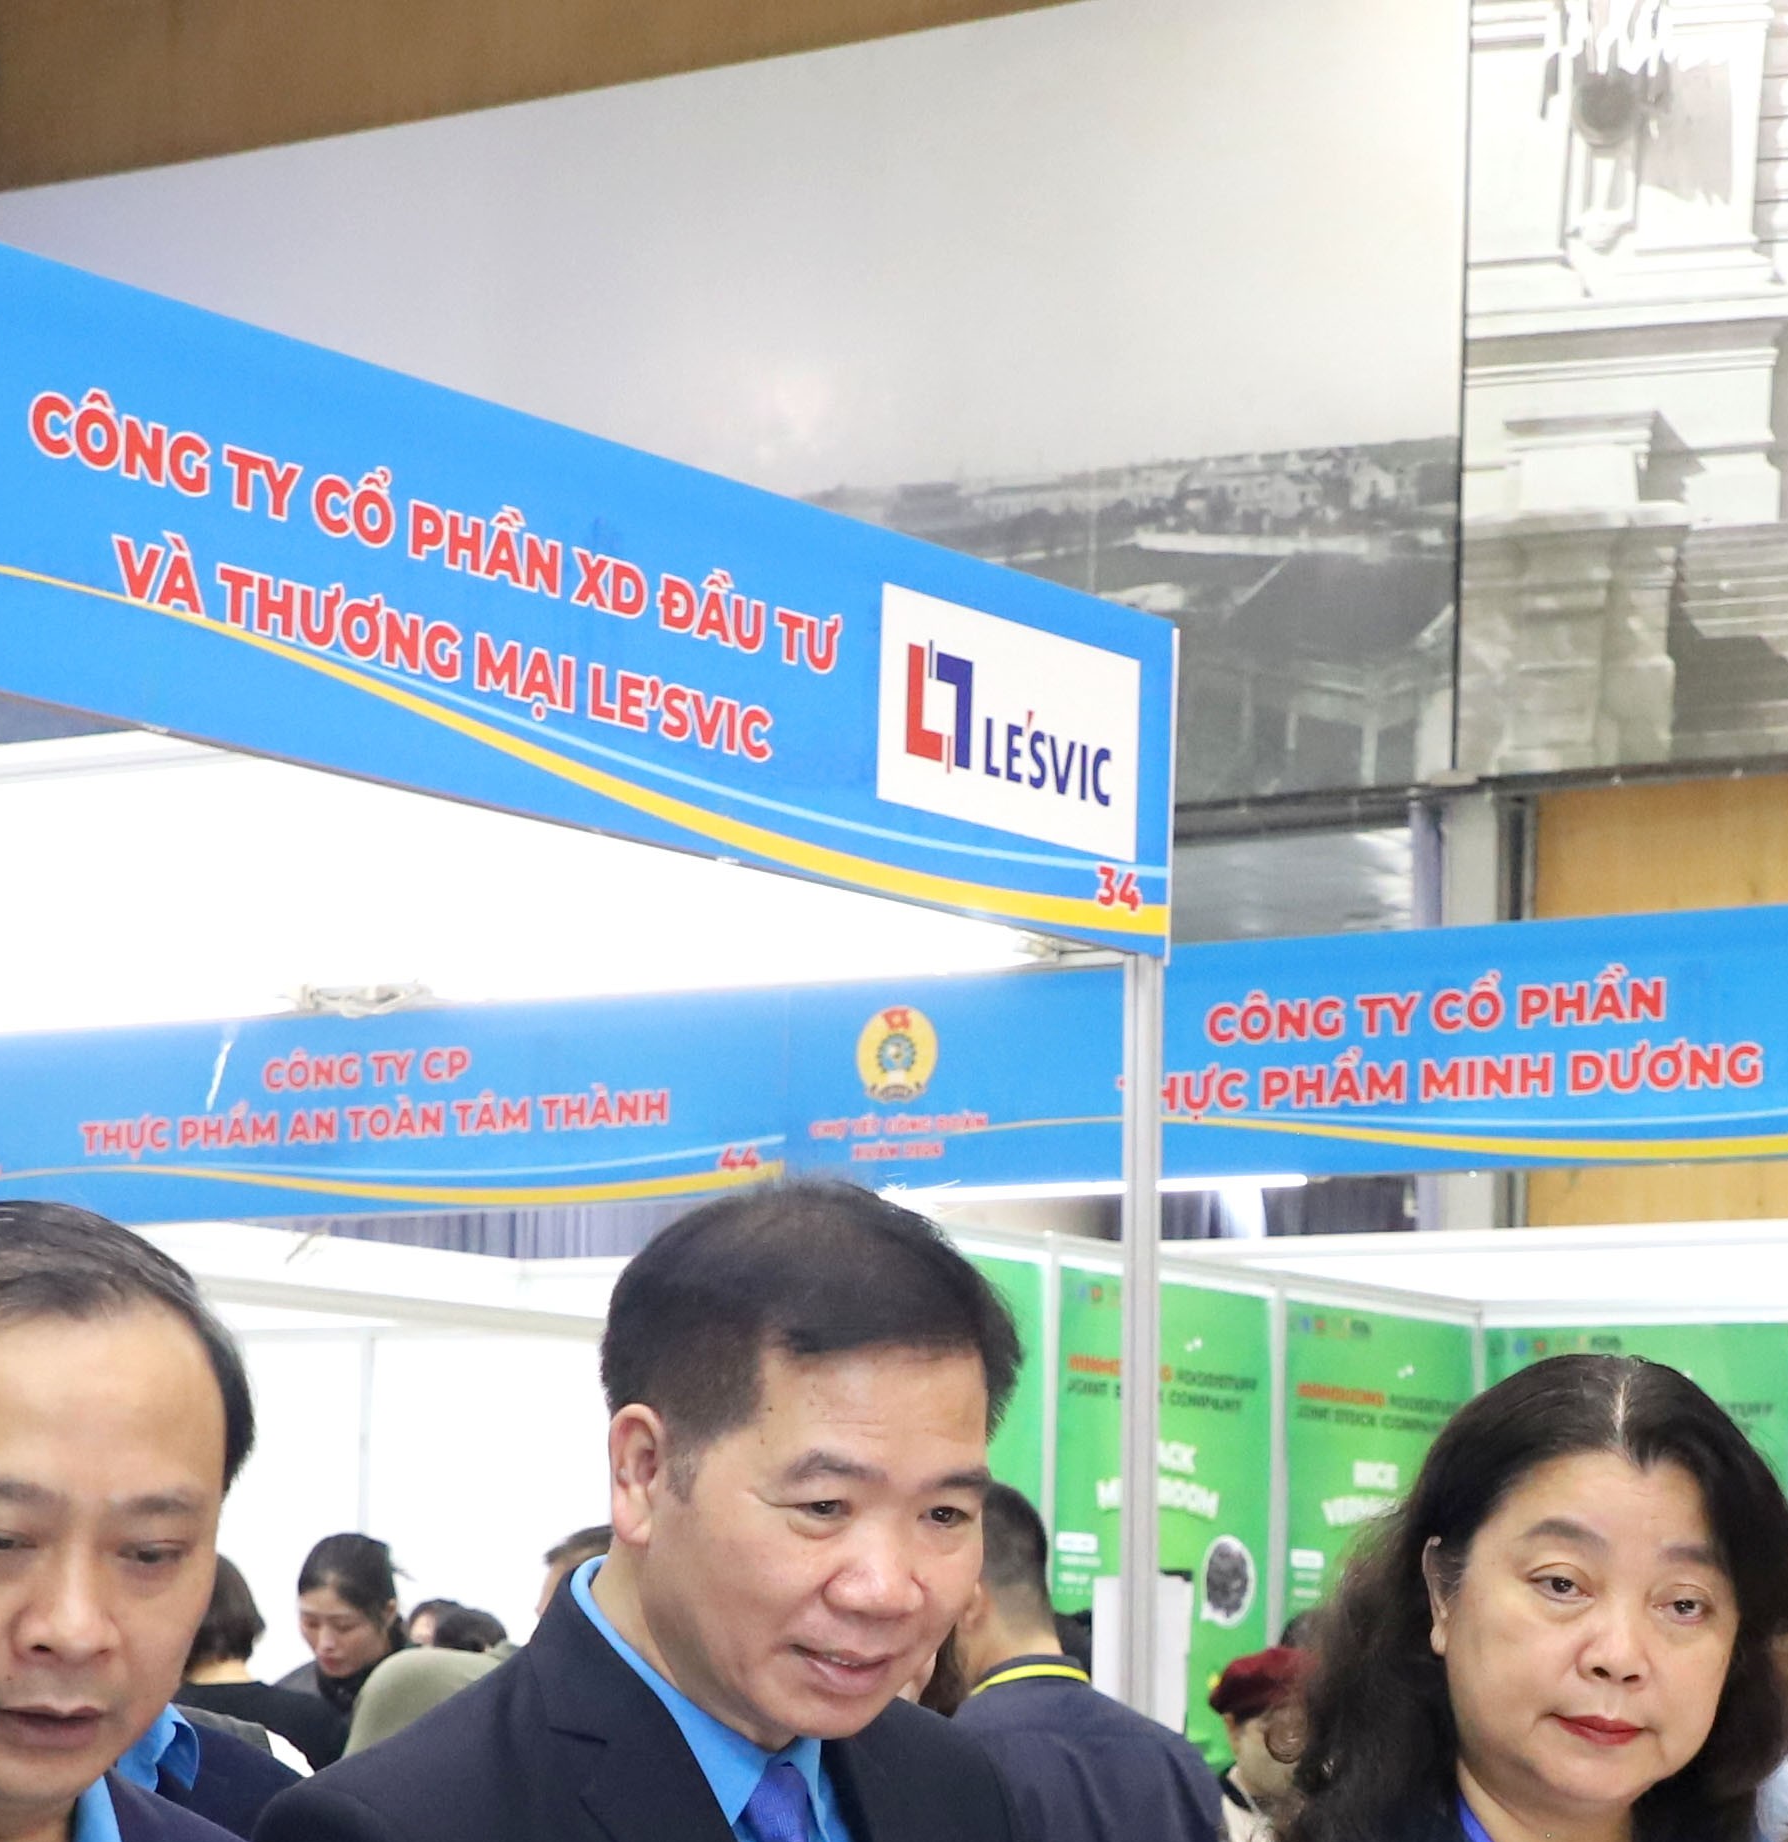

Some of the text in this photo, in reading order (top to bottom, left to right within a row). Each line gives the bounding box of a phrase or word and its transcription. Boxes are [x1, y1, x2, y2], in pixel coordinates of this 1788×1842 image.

[28, 389, 843, 675] CÔNG TY CỔ PHẦN XD ĐẦU TƯ
[112, 530, 204, 617] VÀ
[216, 562, 462, 683] THƯƠNG
[473, 631, 576, 721] MẠI
[1095, 865, 1143, 912] 34
[1205, 962, 1666, 1047] CÔNG TY CỔ PHẦN
[263, 1047, 470, 1091] CÔNG TY CP
[1259, 1046, 1406, 1111] PHẨM
[1420, 1053, 1553, 1106] MINH
[1566, 1040, 1764, 1096] DƯƠNG
[82, 1083, 670, 1160] THỰC PHẨM AN TOÀN TÂM THÀNH
[719, 1144, 761, 1171] 44
